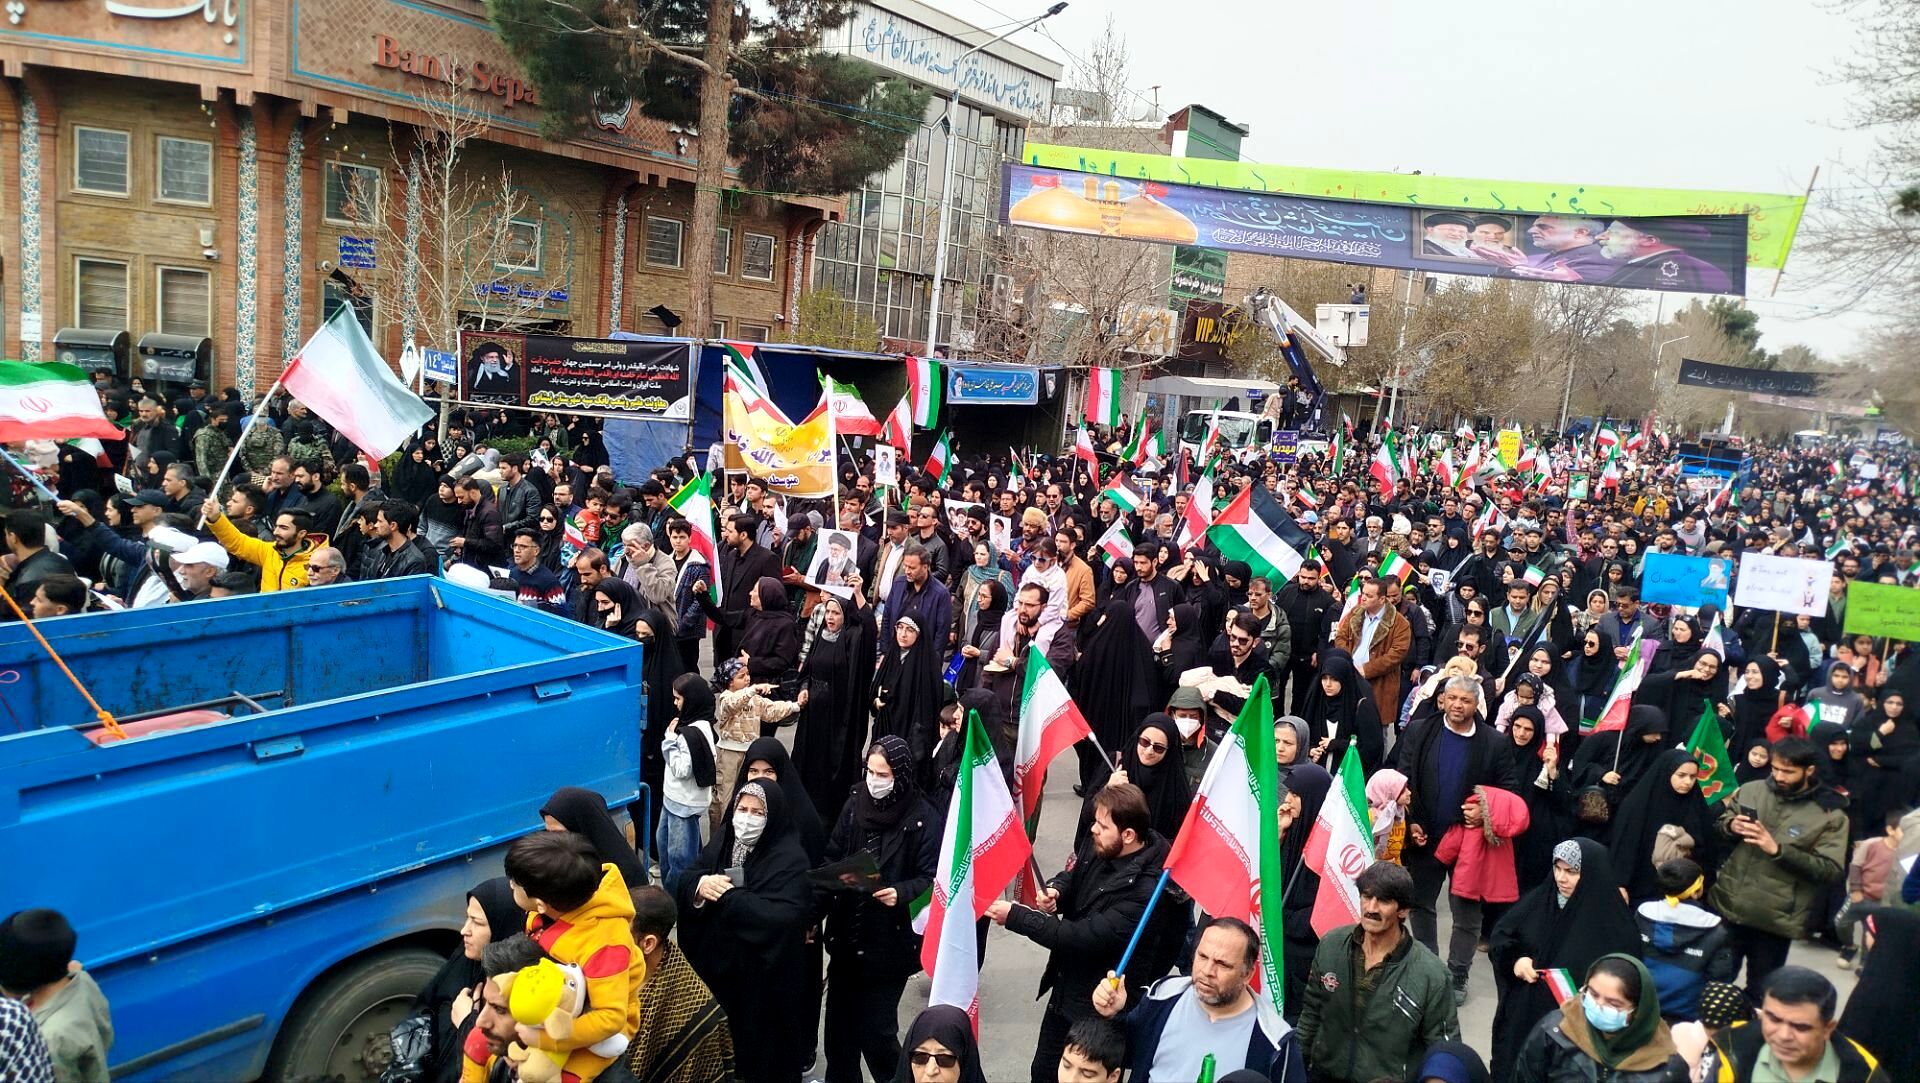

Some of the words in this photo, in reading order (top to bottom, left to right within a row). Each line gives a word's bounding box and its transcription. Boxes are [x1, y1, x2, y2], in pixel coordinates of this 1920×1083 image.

[375, 33, 462, 84] Bank
[471, 60, 540, 107] Sepa
[1195, 316, 1215, 342] VIP
